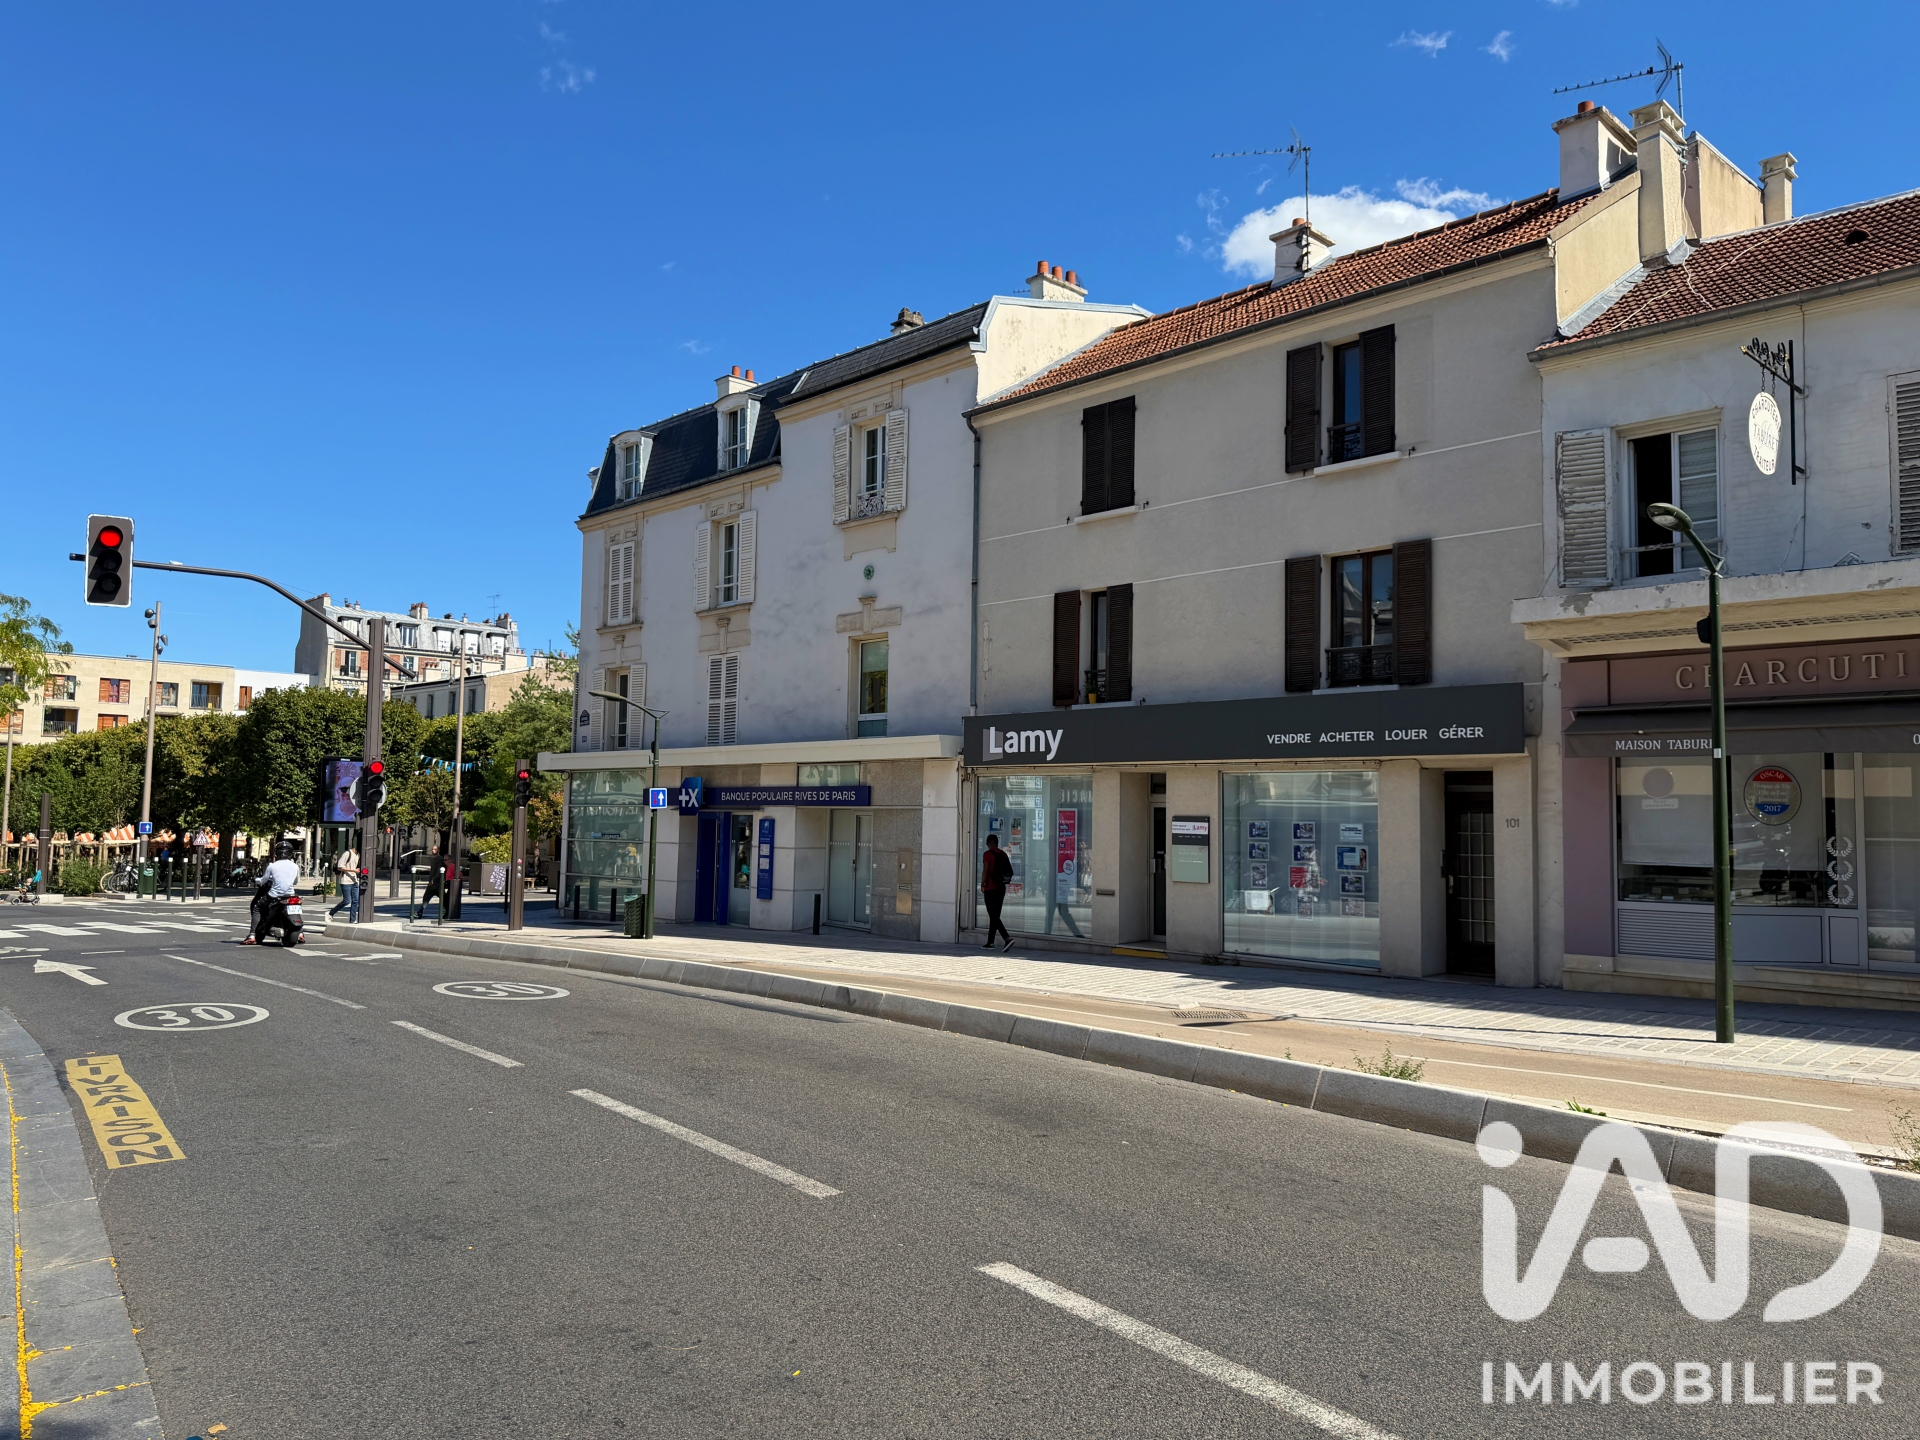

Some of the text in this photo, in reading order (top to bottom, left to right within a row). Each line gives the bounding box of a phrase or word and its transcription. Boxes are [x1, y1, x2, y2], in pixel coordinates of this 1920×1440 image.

[1266, 723, 1484, 745] VENDRE ACHETER LOUER GÉRER
[989, 726, 1064, 761] Lamy
[1615, 739, 1661, 751] MAISON
[1759, 770, 1785, 780] OSCAR
[721, 790, 856, 802] BANQUE POPULAIRE RIVES DE PARIS
[1764, 804, 1782, 812] 2017
[1505, 817, 1520, 828] 101
[453, 983, 545, 997] 30
[145, 1006, 236, 1028] 30
[77, 1059, 175, 1166] LIVRAISON
